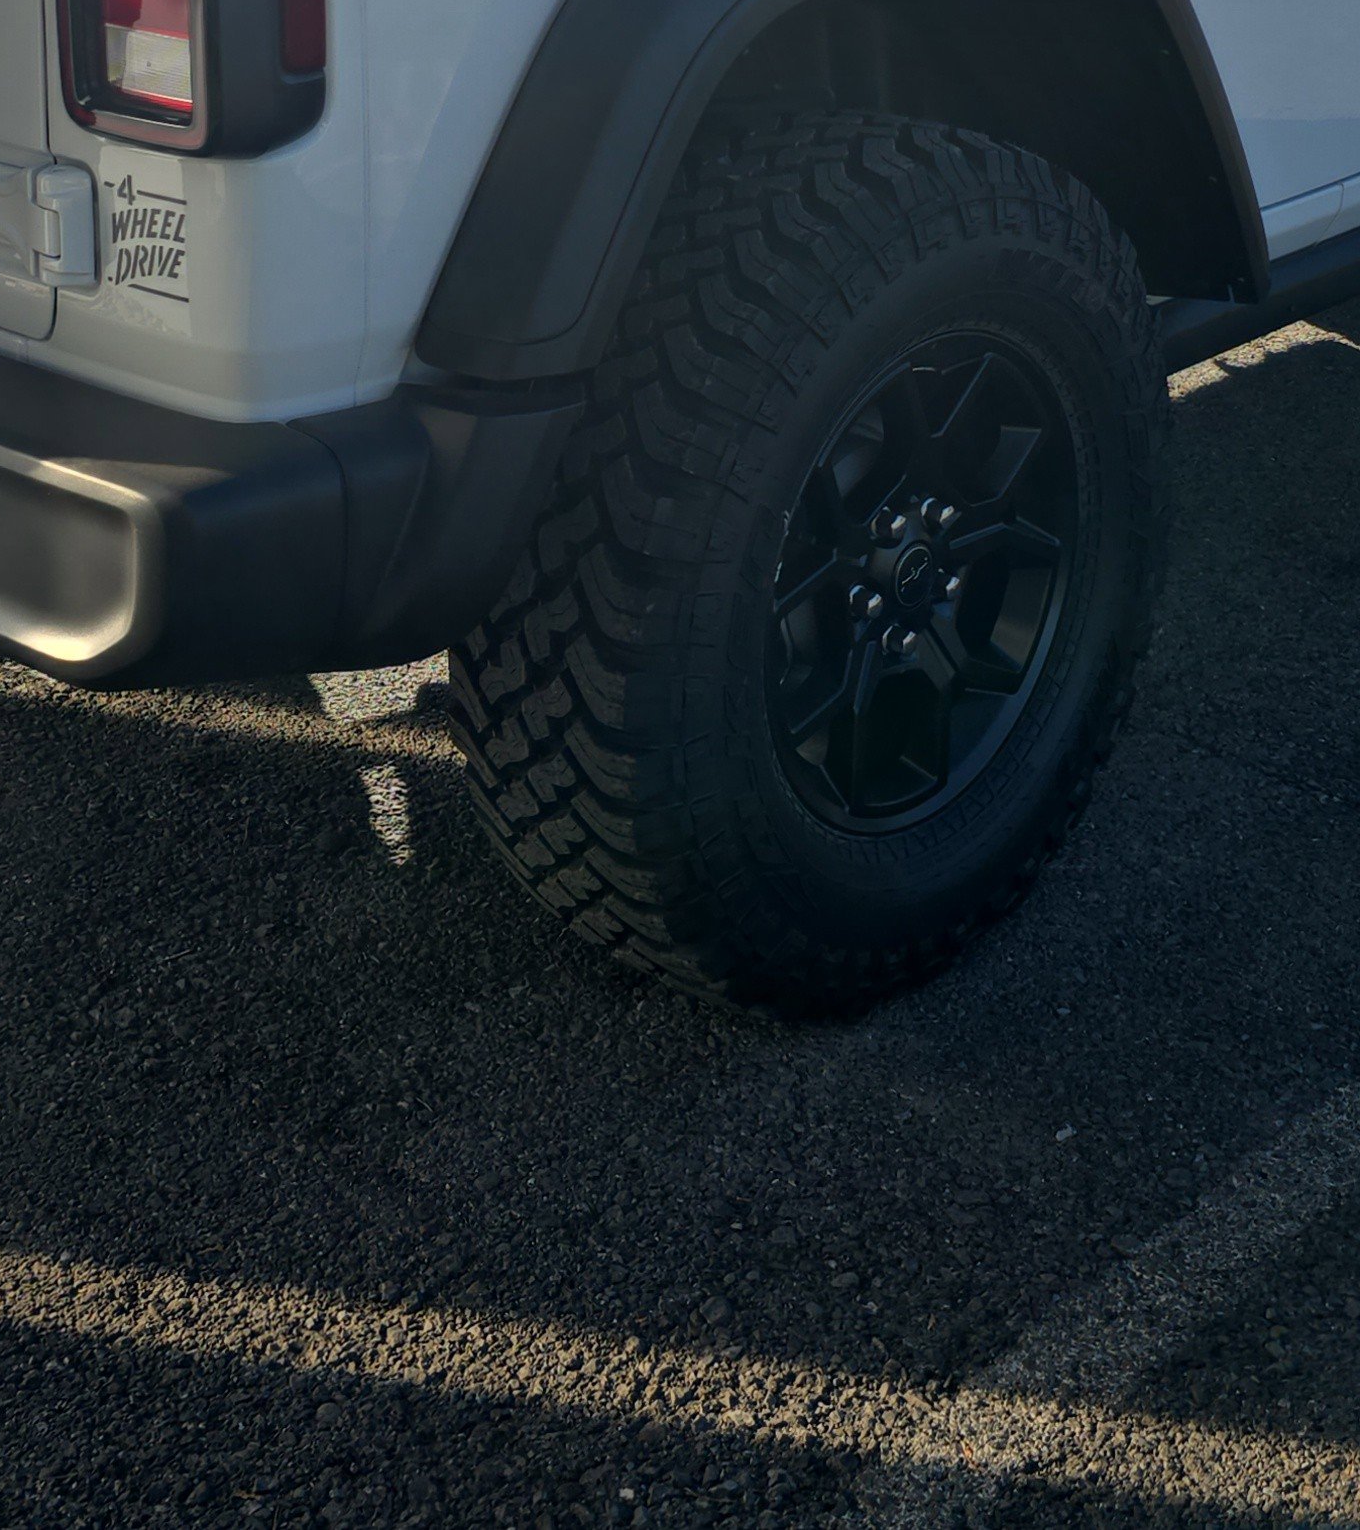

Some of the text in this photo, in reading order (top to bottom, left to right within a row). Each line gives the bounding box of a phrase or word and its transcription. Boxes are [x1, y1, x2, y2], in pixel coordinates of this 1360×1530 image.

[116, 174, 136, 205] 4
[111, 207, 186, 244] WHEEL
[115, 244, 186, 286] DRIVE
